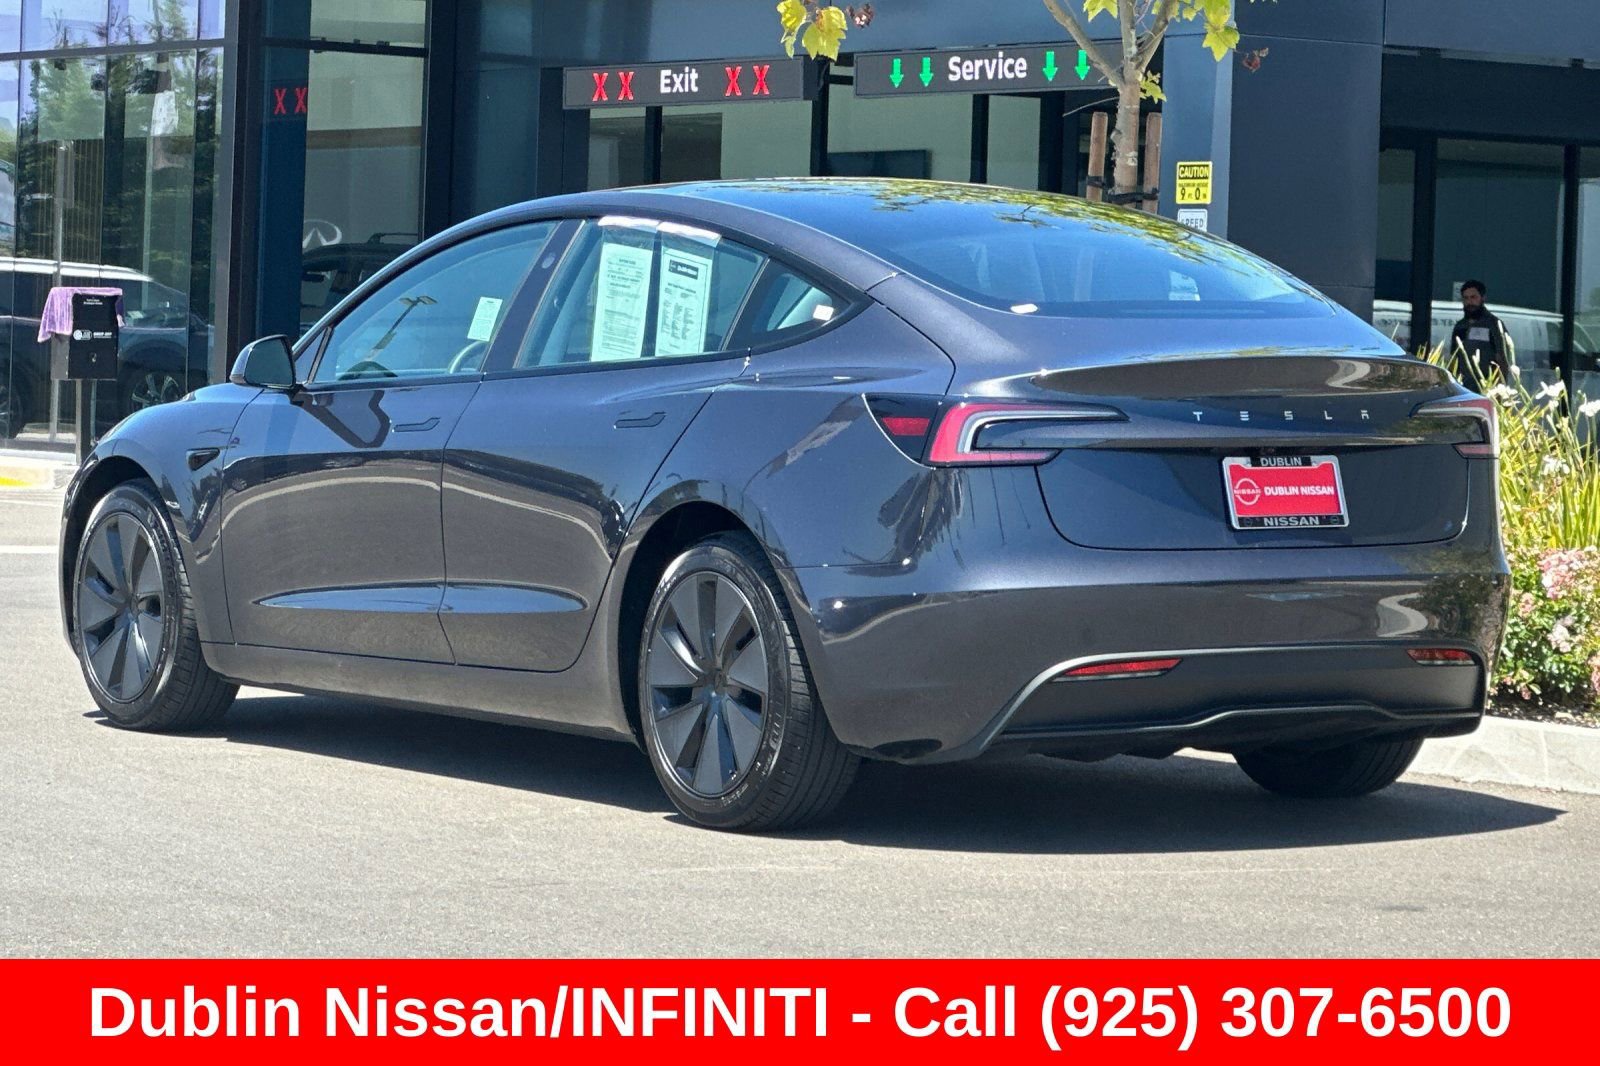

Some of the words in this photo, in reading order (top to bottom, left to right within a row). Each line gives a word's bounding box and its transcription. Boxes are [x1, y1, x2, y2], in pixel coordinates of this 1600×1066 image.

[948, 51, 1027, 82] Service
[659, 66, 699, 94] Exit
[1179, 166, 1209, 178] CAUTION
[1180, 187, 1186, 200] 9
[1194, 187, 1201, 200] 0
[1193, 410, 1370, 422] TESLA
[1260, 457, 1303, 467] DUBLIN
[1233, 488, 1261, 496] NISSAN
[1264, 485, 1299, 496] DUBLIN
[1300, 485, 1335, 496] NISSAN
[1263, 515, 1320, 527] NISSAN
